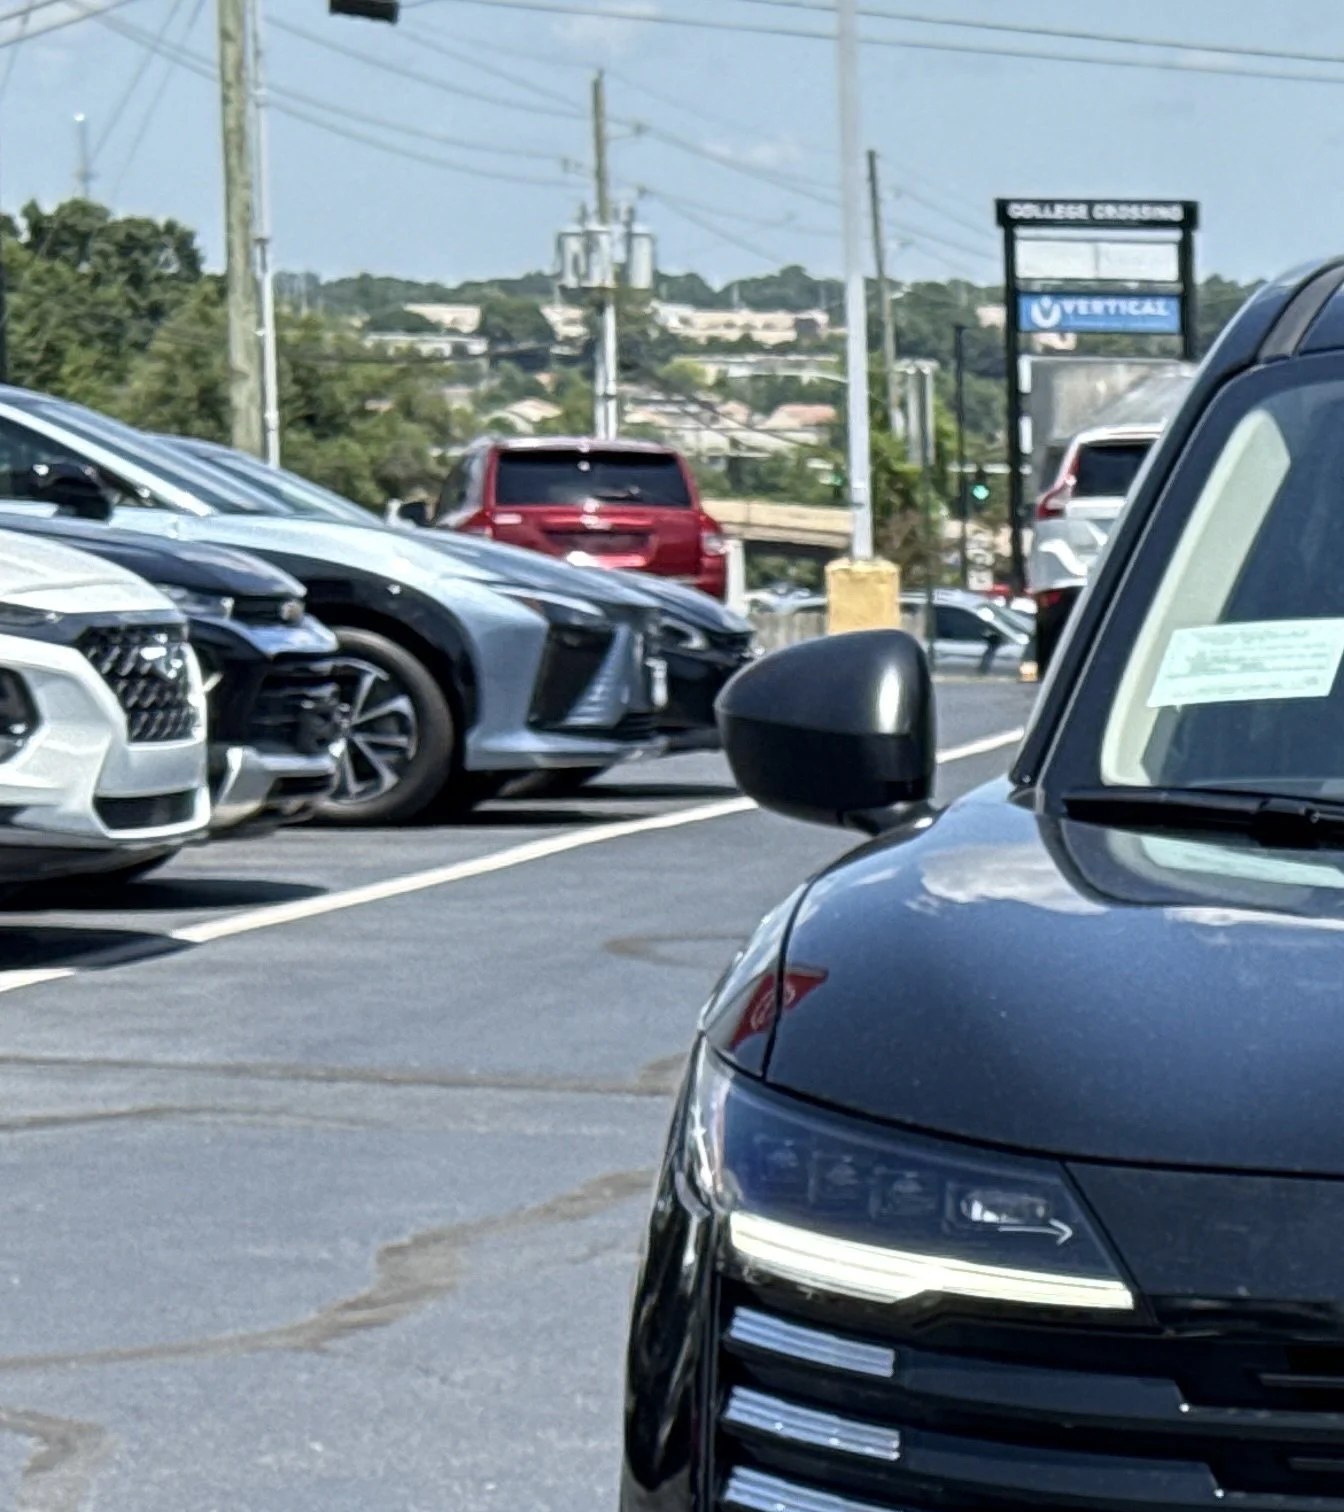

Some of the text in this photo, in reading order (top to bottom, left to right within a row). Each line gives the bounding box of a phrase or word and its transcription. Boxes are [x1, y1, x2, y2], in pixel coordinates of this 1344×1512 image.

[1006, 202, 1184, 222] COLLEGE CROSSING
[1063, 299, 1171, 317] VERTICAL
